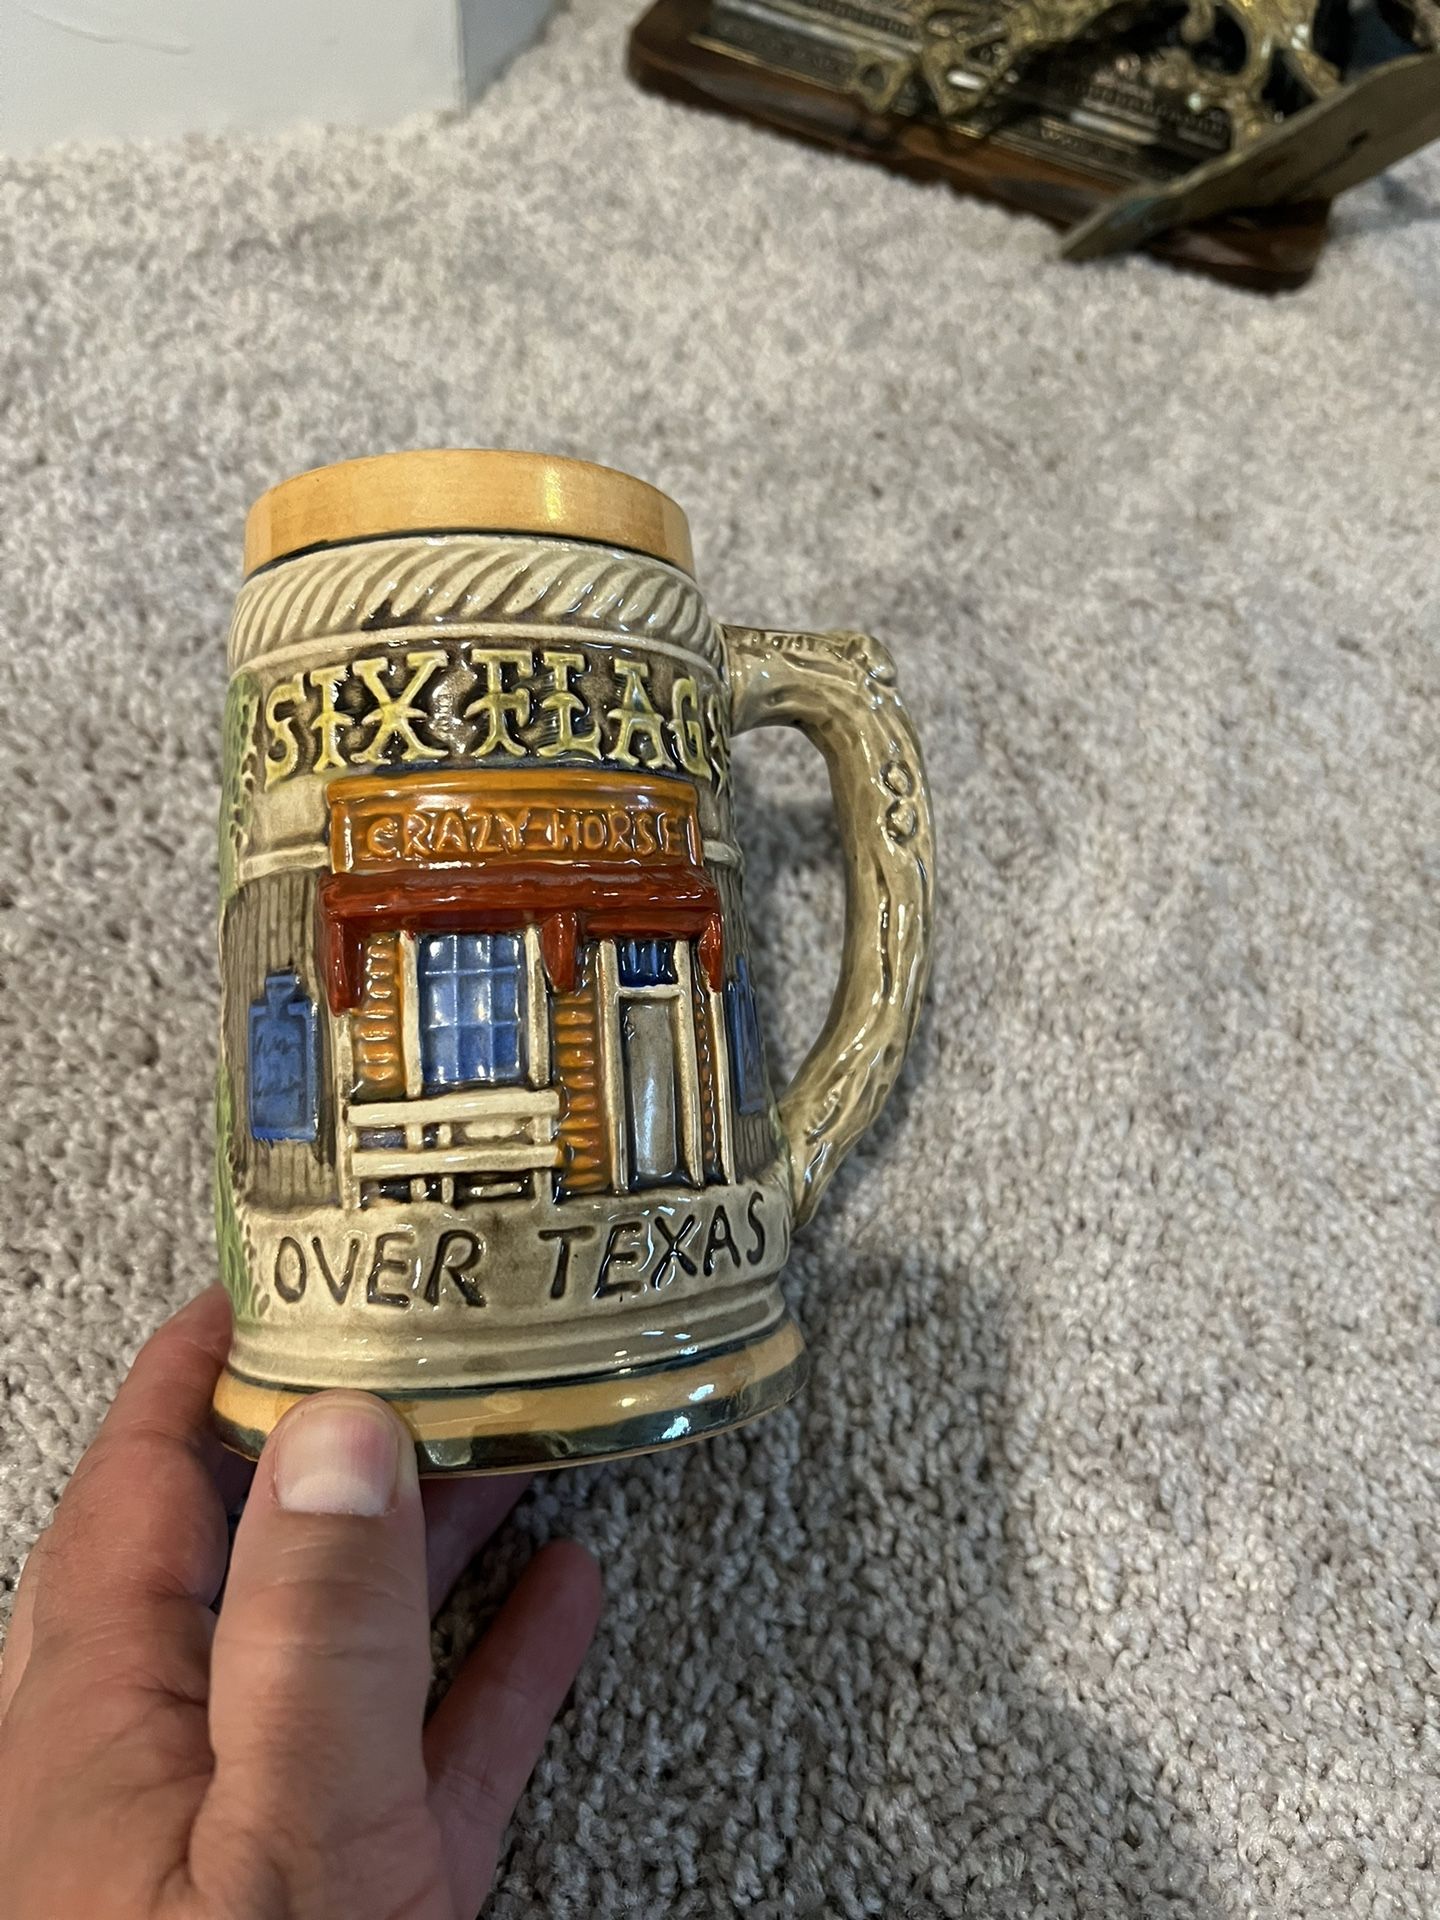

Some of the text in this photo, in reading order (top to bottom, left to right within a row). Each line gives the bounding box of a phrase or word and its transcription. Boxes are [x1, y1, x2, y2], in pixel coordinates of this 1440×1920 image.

[262, 648, 449, 793] SIX
[366, 808, 683, 857] CRAZY HORSE
[273, 1190, 765, 1308] OVER TEXAS
